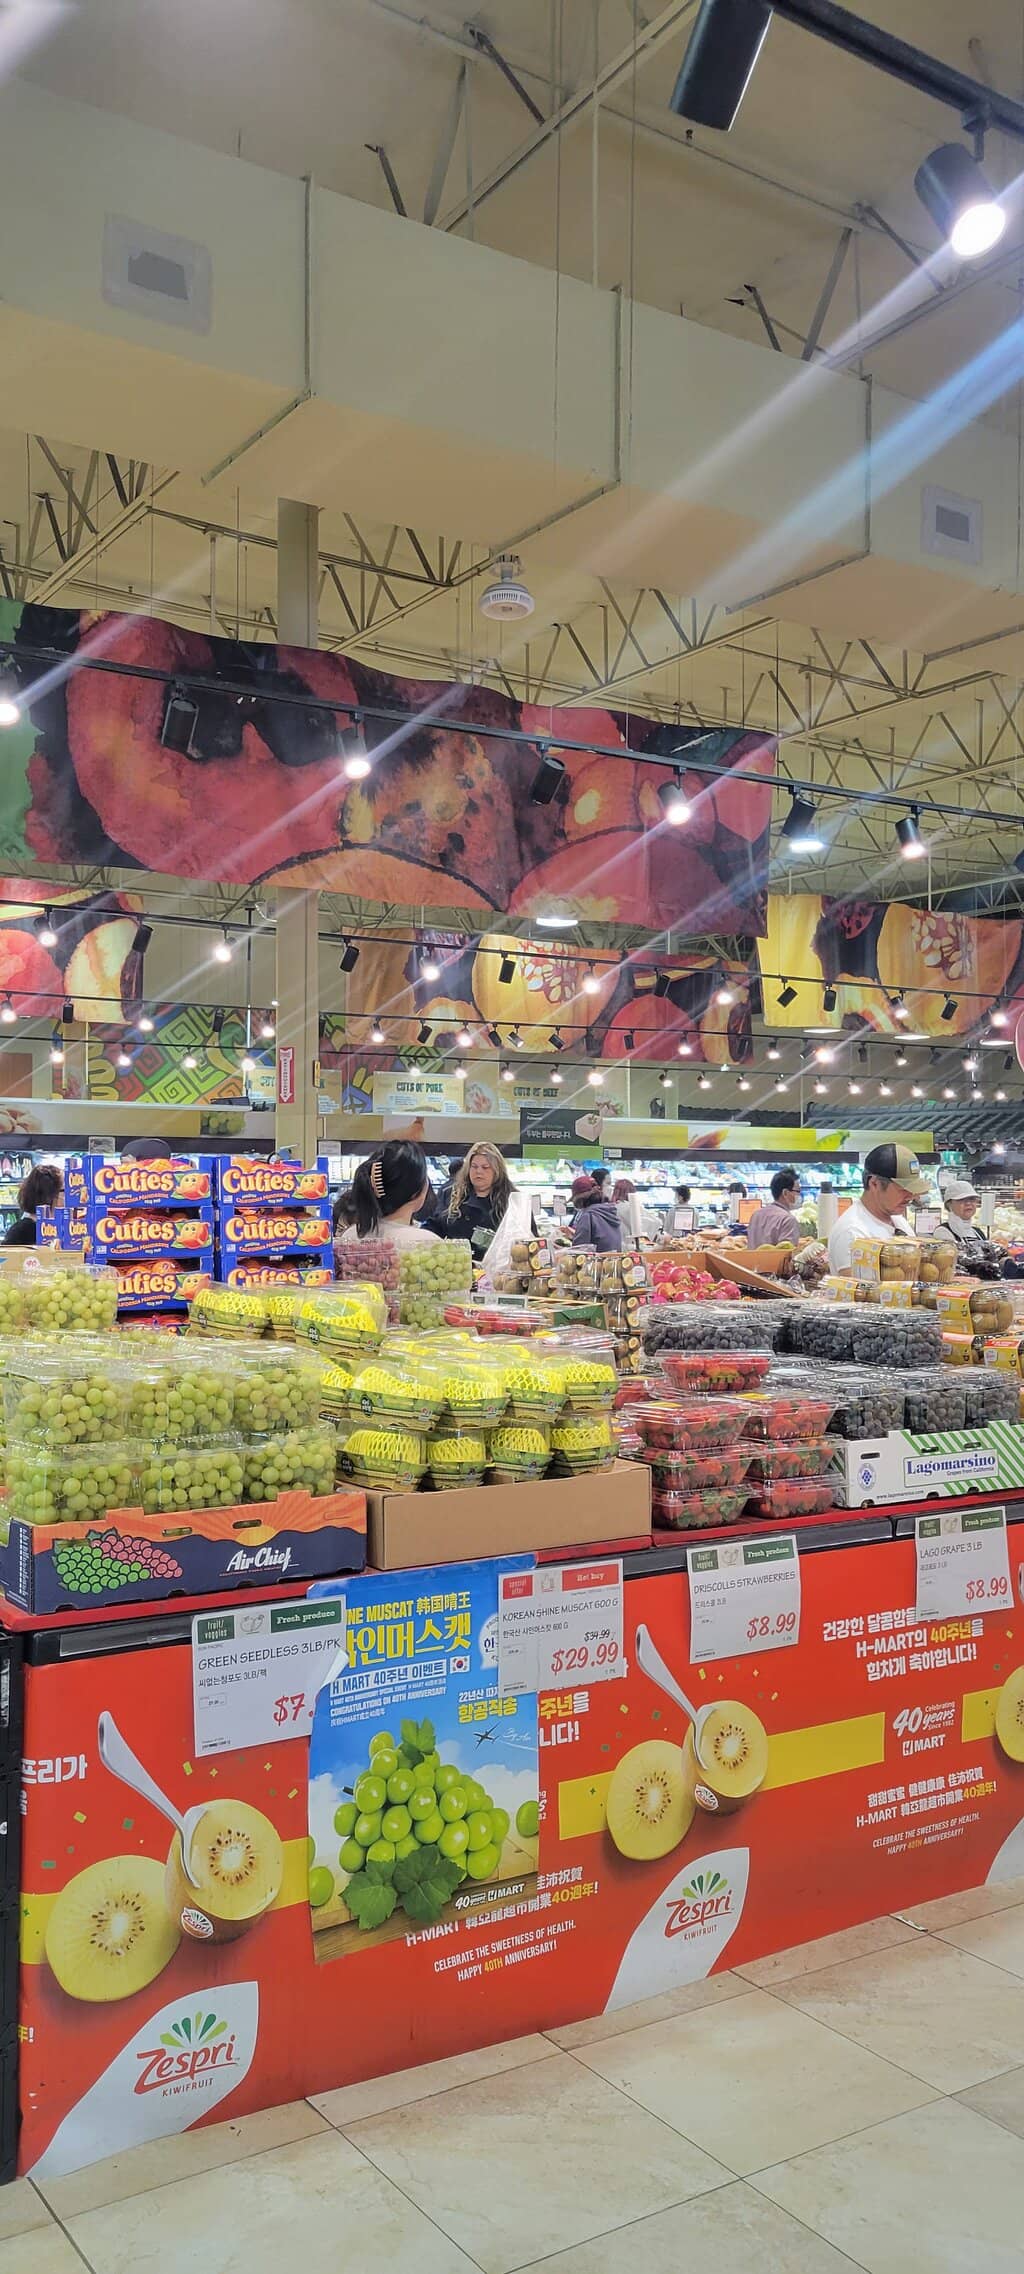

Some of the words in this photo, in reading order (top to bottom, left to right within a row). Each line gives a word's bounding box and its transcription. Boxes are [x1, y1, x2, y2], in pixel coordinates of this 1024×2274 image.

[94, 1164, 174, 1193] Cuties
[222, 1167, 295, 1194] Cuties
[96, 1216, 175, 1244] Cuties
[226, 1217, 298, 1245] Cuties
[117, 1273, 176, 1294] uties
[907, 1454, 996, 1476] Lagomarsino
[226, 1549, 254, 1572] Air
[255, 1547, 292, 1572] Chief
[747, 1550, 765, 1558] Fresh
[766, 1547, 790, 1557] produce
[920, 1548, 940, 1559] LAGO
[940, 1544, 965, 1556] GRAPE
[967, 1543, 973, 1552] 3
[693, 1580, 736, 1594] DRISCOLLS
[737, 1571, 796, 1588] STRAWBERRIES
[966, 1577, 1008, 1603] $8.99
[276, 1615, 301, 1625] Fresh
[302, 1610, 336, 1622] produce
[366, 1600, 414, 1623] MUSCAT
[416, 1591, 472, 1616] 韩国晴王
[502, 1610, 535, 1622] KOREAN
[536, 1607, 560, 1618] SHINE
[561, 1602, 594, 1614] MUSCAT
[204, 1630, 228, 1640] veggies
[584, 1629, 611, 1642] $34.99
[747, 1611, 796, 1642] $8.99
[823, 1616, 864, 1642] 건강한
[856, 1628, 928, 1658] H-MART의
[930, 1618, 984, 1644] 40주년을
[198, 1654, 237, 1671] GREEN
[240, 1645, 299, 1664] SEEDLESS
[301, 1638, 341, 1654] 3LB/PK
[551, 1642, 619, 1676] $29.99
[866, 1656, 907, 1682] 힘차게
[909, 1643, 977, 1672] 축하합니다!
[332, 1679, 342, 1695] H
[343, 1673, 370, 1693] MART
[373, 1667, 408, 1686] 40주년
[412, 1662, 445, 1679] 이벤트
[330, 1698, 382, 1717] CONGRATULATIONS
[407, 1686, 448, 1700] ANNIVERSARY
[458, 1690, 485, 1703] 22년산
[540, 1691, 590, 1720] 주년을
[893, 1707, 923, 1738] 40
[925, 1701, 956, 1712] Celebrating
[922, 1709, 956, 1730] years
[539, 1720, 581, 1748] 니다!
[914, 1733, 946, 1753] MART
[856, 1807, 898, 1828] H-MART
[872, 1832, 905, 1848] CELEBRATE
[905, 1829, 916, 1839] THE
[916, 1820, 950, 1836] SWEETNESS
[950, 1818, 958, 1827] OF
[887, 1844, 907, 1855] HAPPY
[923, 1828, 964, 1845] ANNIVERSARY!
[455, 1895, 471, 1910] 40
[498, 1883, 525, 1897] MART
[664, 1889, 733, 1938] Zespri
[405, 1920, 460, 1947] H-MART
[434, 1952, 475, 1973] CELEBRATE
[476, 1946, 490, 1959] THE
[491, 1934, 534, 1954] SWEETNESS
[535, 1927, 546, 1939] OF
[547, 1919, 577, 1936] HEALTH.
[683, 1924, 718, 1941] KIWIFRUIT
[457, 1964, 483, 1982] HAPPY
[484, 1957, 504, 1972] 40TH
[504, 1939, 558, 1966] ANNIVERSARY!
[134, 2034, 240, 2095] Zespri
[161, 2078, 214, 2098] KIWIFRUIT
